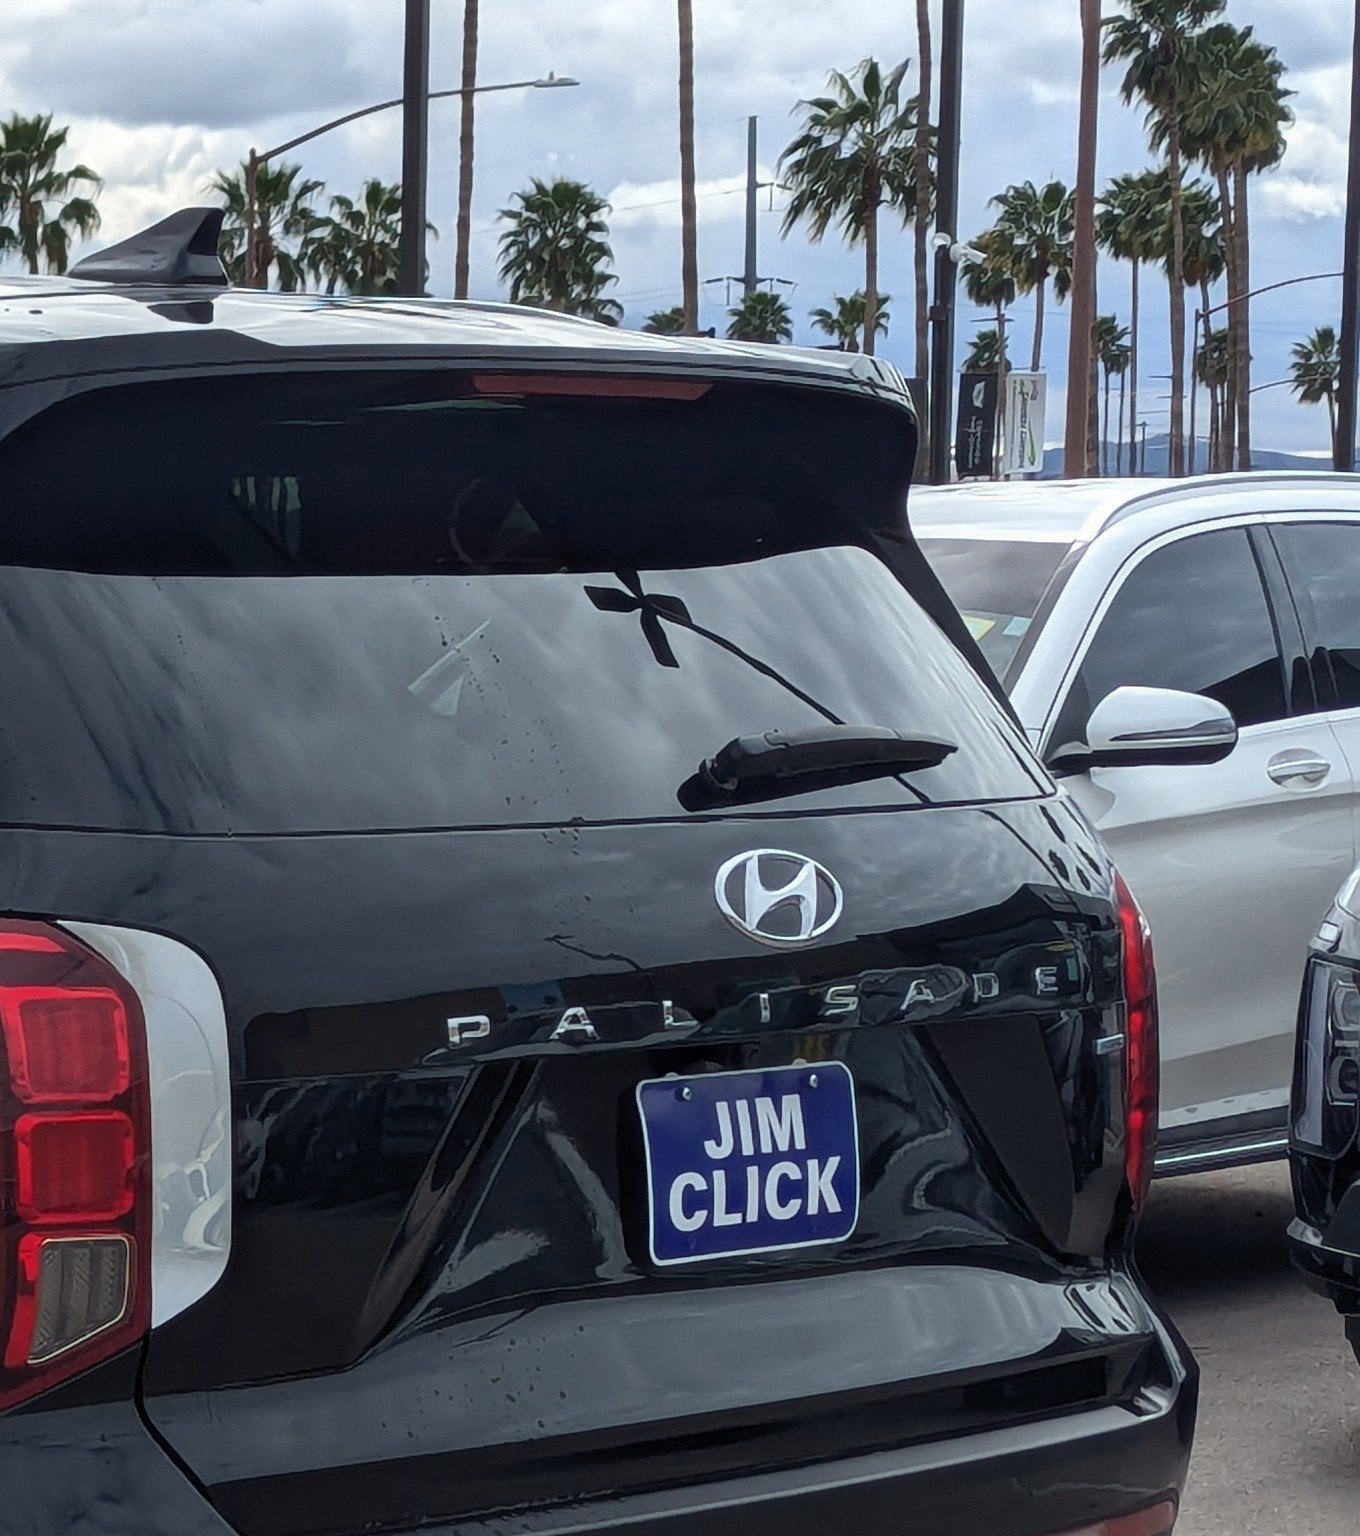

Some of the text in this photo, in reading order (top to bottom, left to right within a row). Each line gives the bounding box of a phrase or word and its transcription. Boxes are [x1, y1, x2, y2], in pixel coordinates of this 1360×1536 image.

[447, 966, 1059, 1045] PALISADE
[703, 1094, 806, 1160] JIM
[669, 1155, 842, 1232] CLICK
